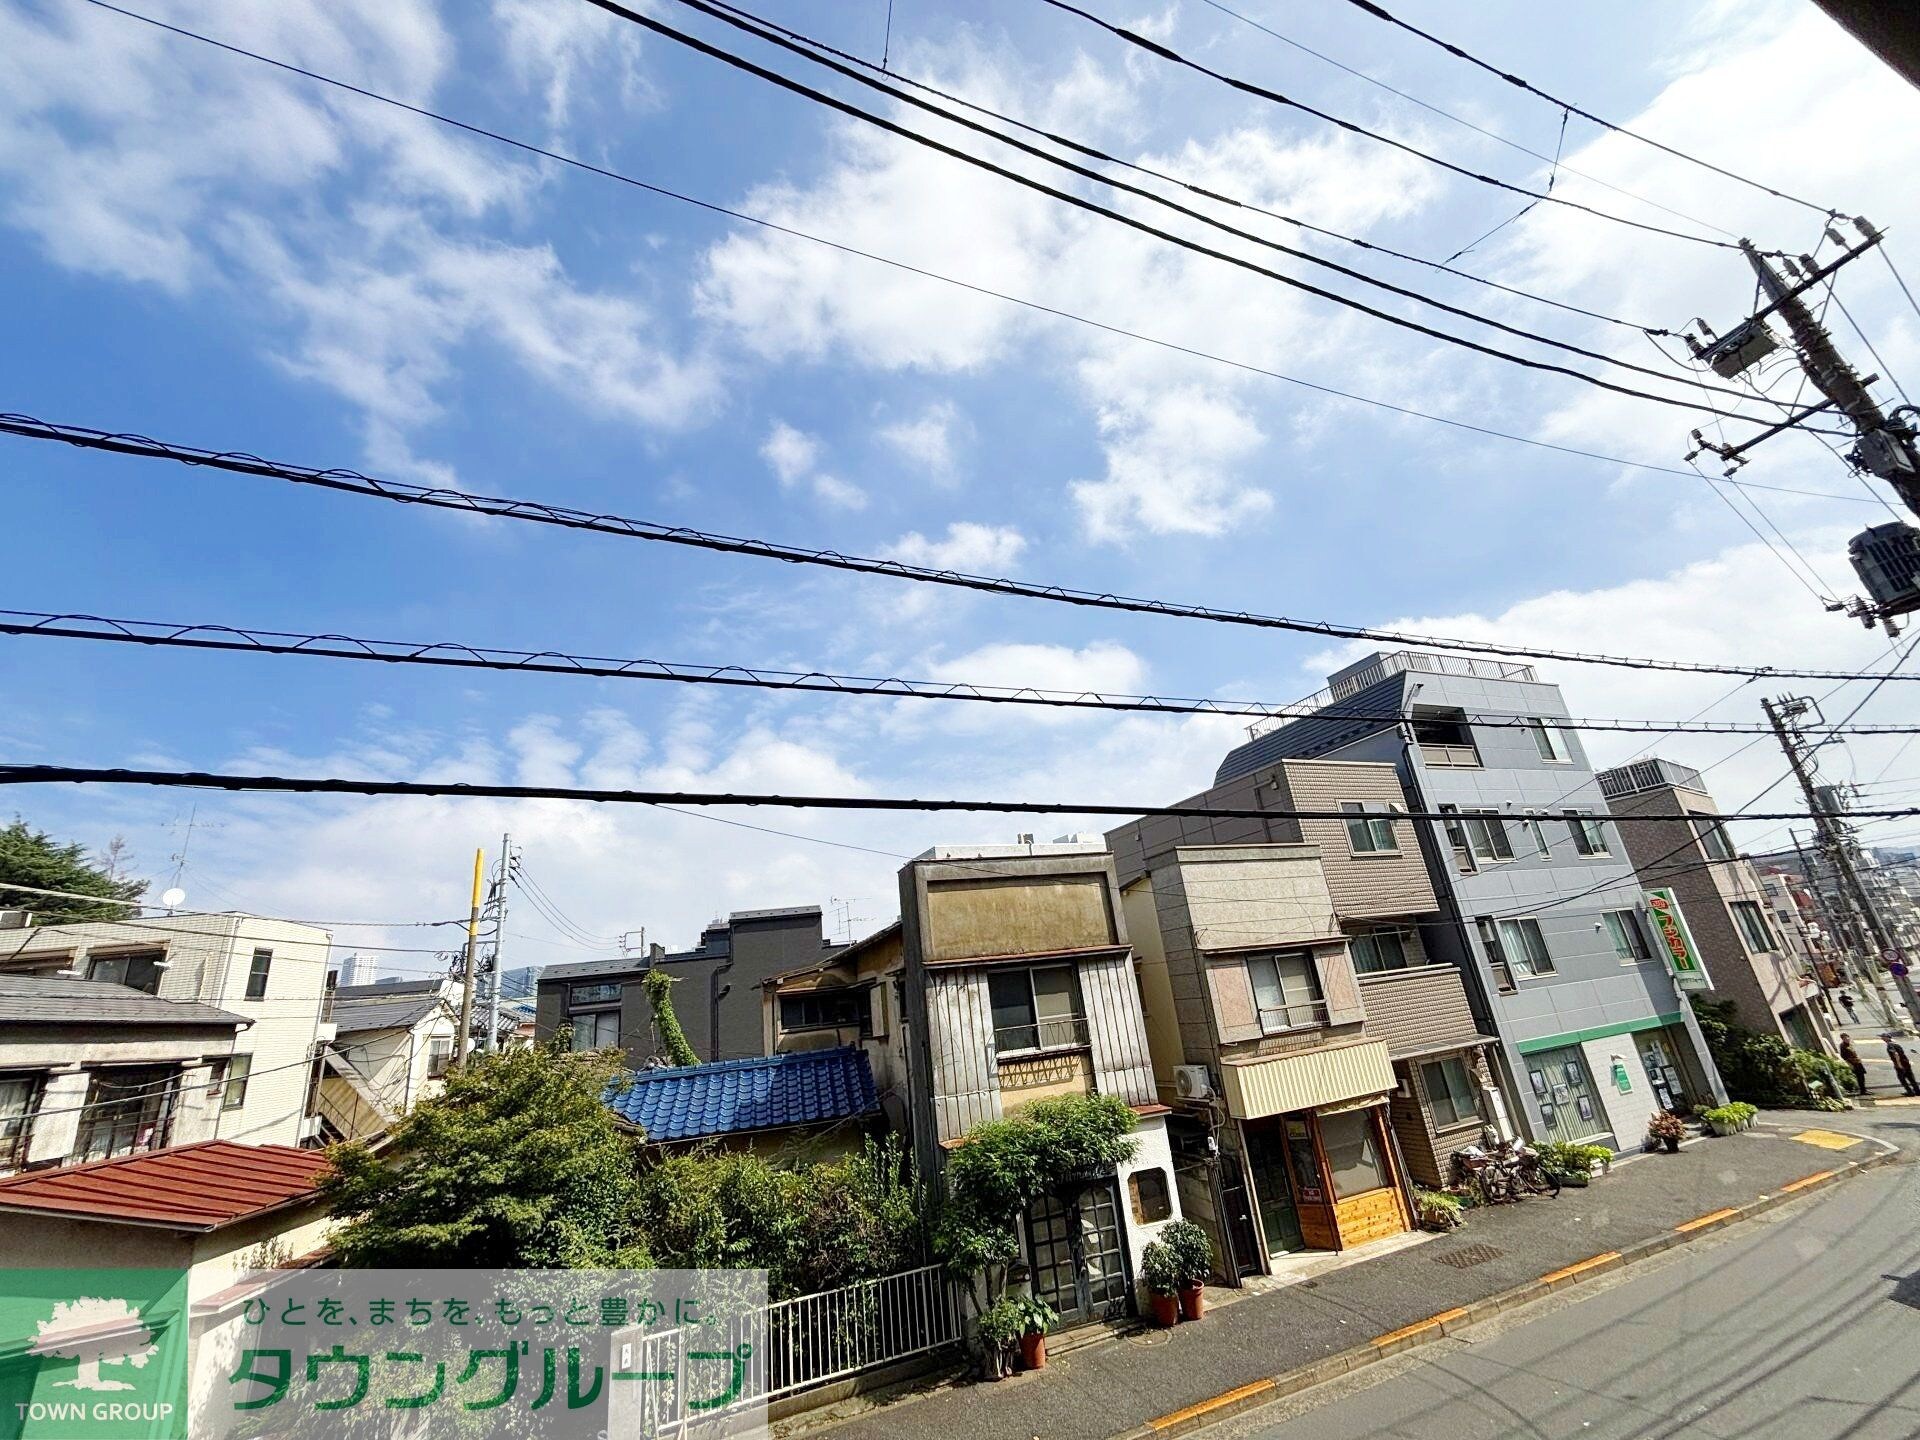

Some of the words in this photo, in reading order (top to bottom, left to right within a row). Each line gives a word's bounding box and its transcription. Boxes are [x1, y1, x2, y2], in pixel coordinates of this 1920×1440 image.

[1658, 915, 1689, 969] フジカラー
